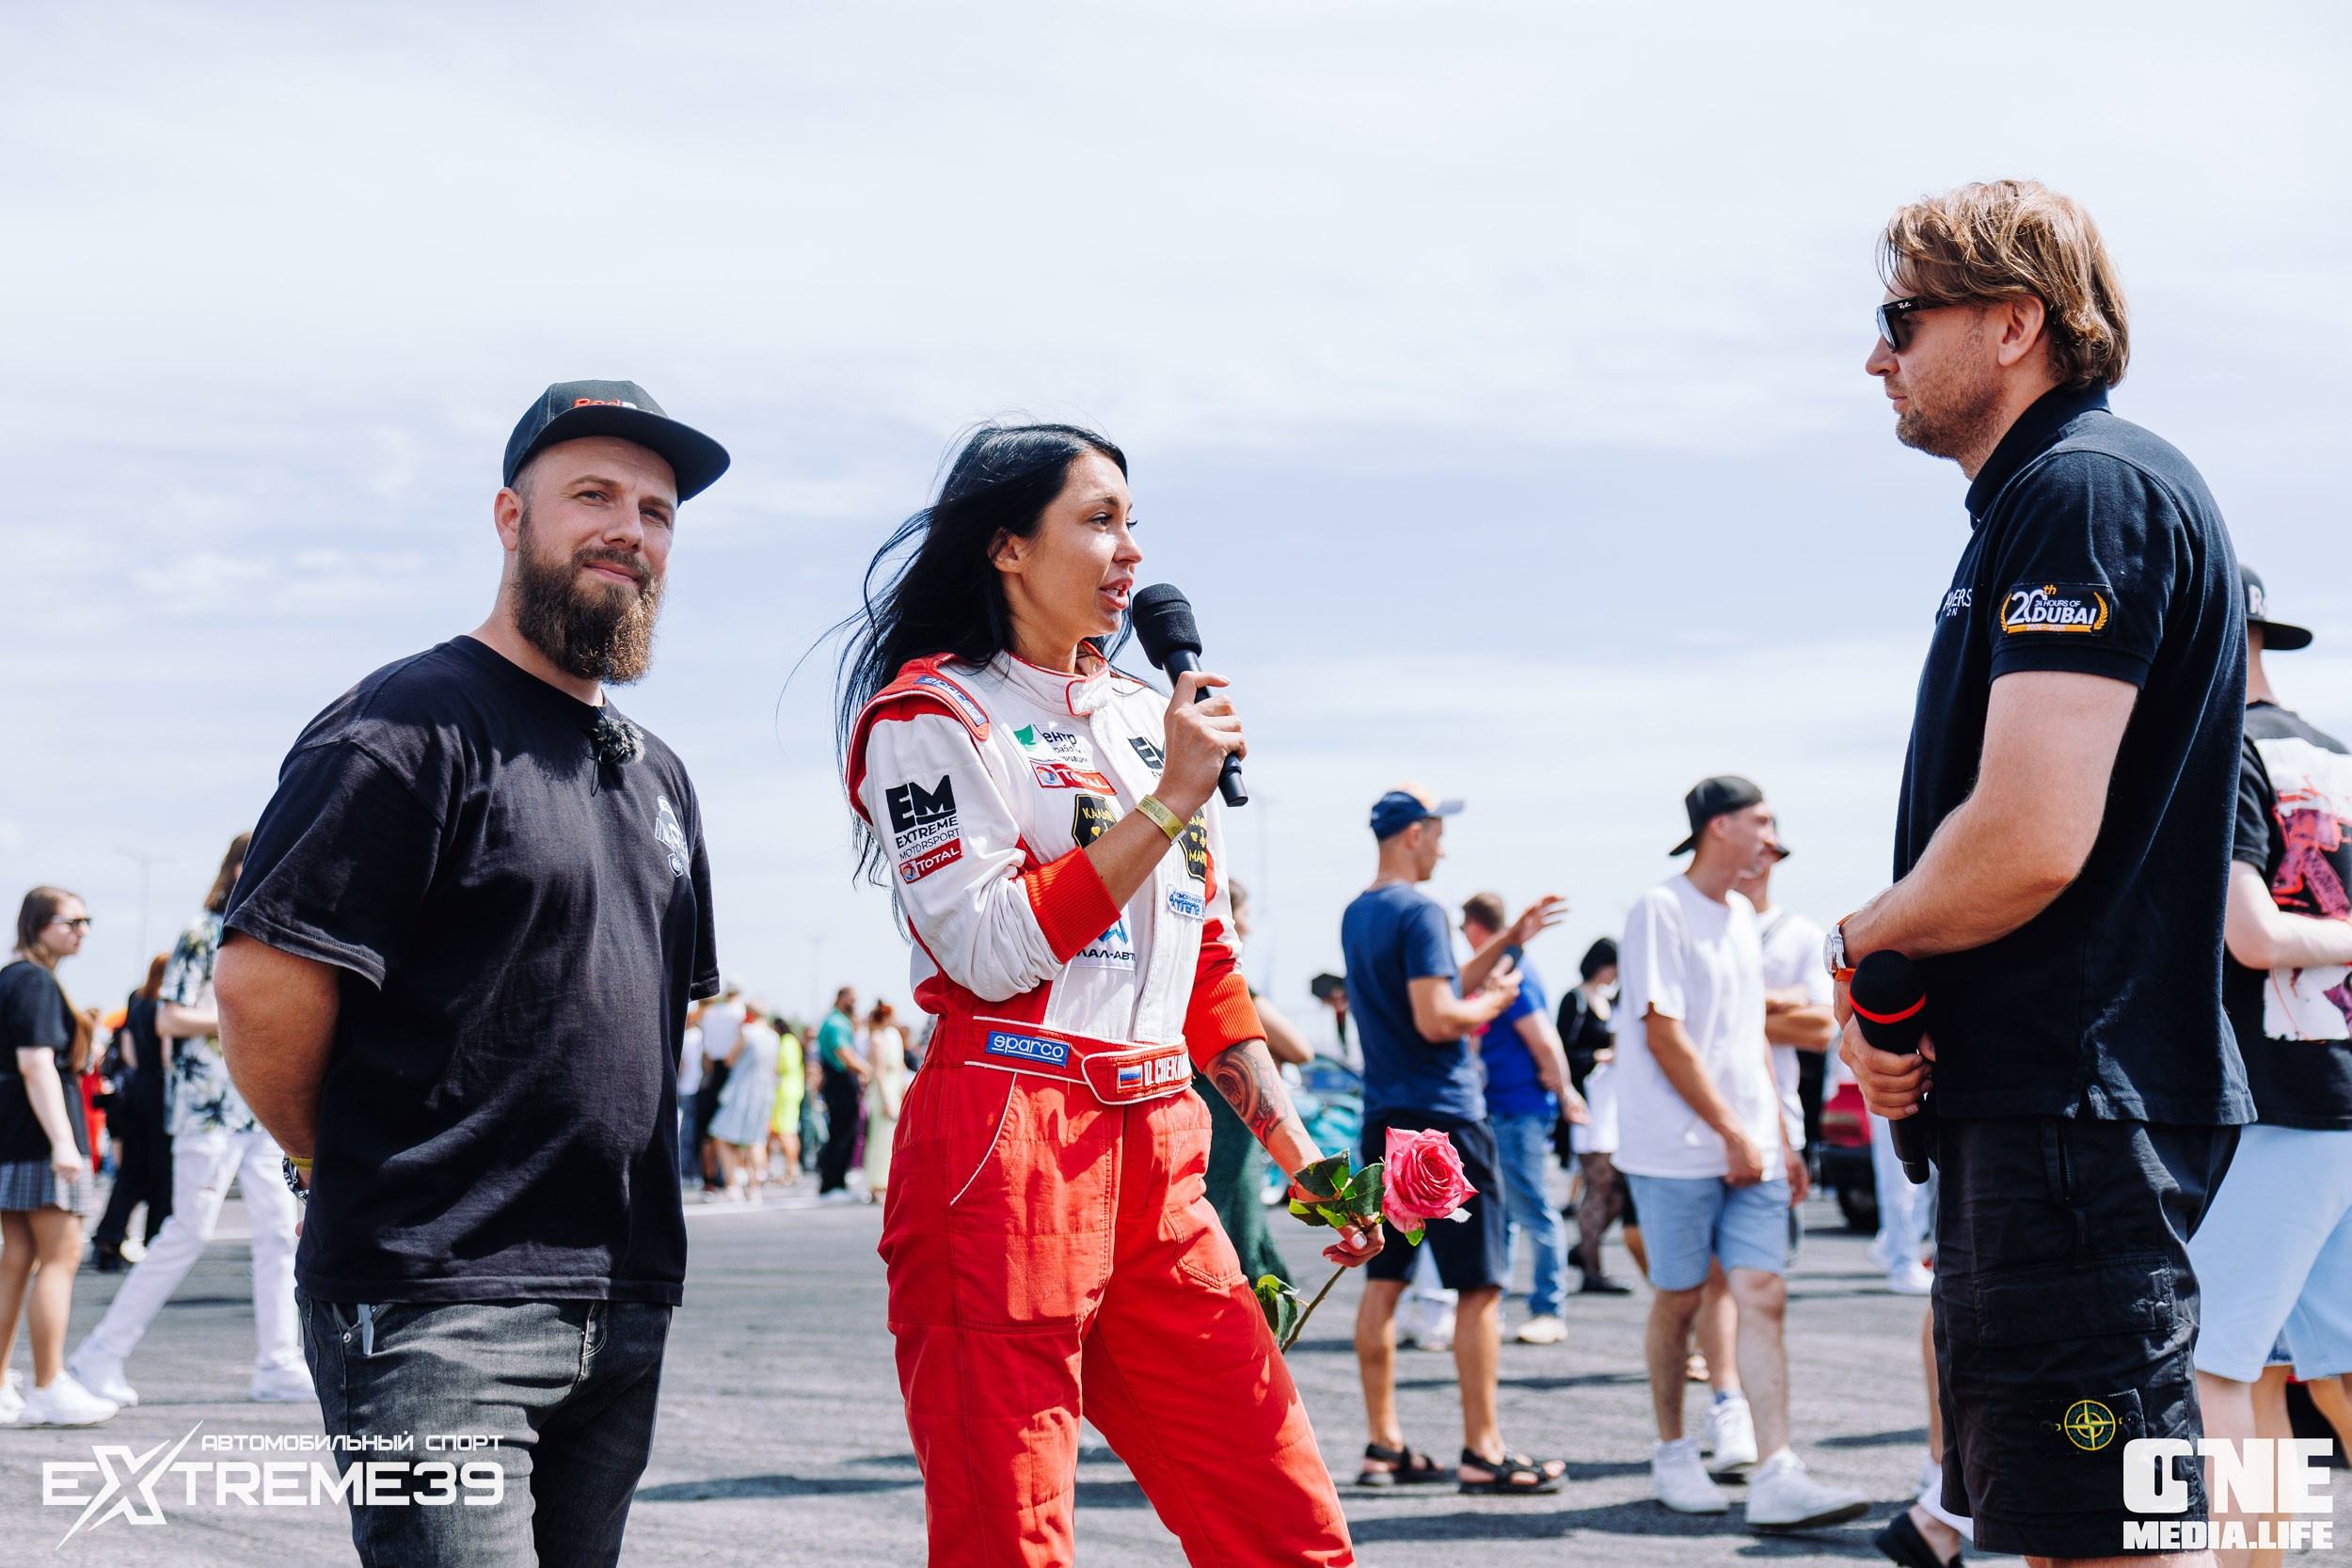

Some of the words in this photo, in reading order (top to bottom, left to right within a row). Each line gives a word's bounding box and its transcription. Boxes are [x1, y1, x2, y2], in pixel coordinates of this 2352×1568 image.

[2031, 607, 2097, 625] DUBAI
[925, 677, 981, 719] sparco
[1037, 729, 1077, 748] ентр
[885, 774, 957, 834] EM
[896, 816, 959, 849] EXTREME
[898, 828, 961, 862] MOTORSPORT
[916, 847, 960, 872] TOTAL
[993, 1035, 1064, 1058] sparco
